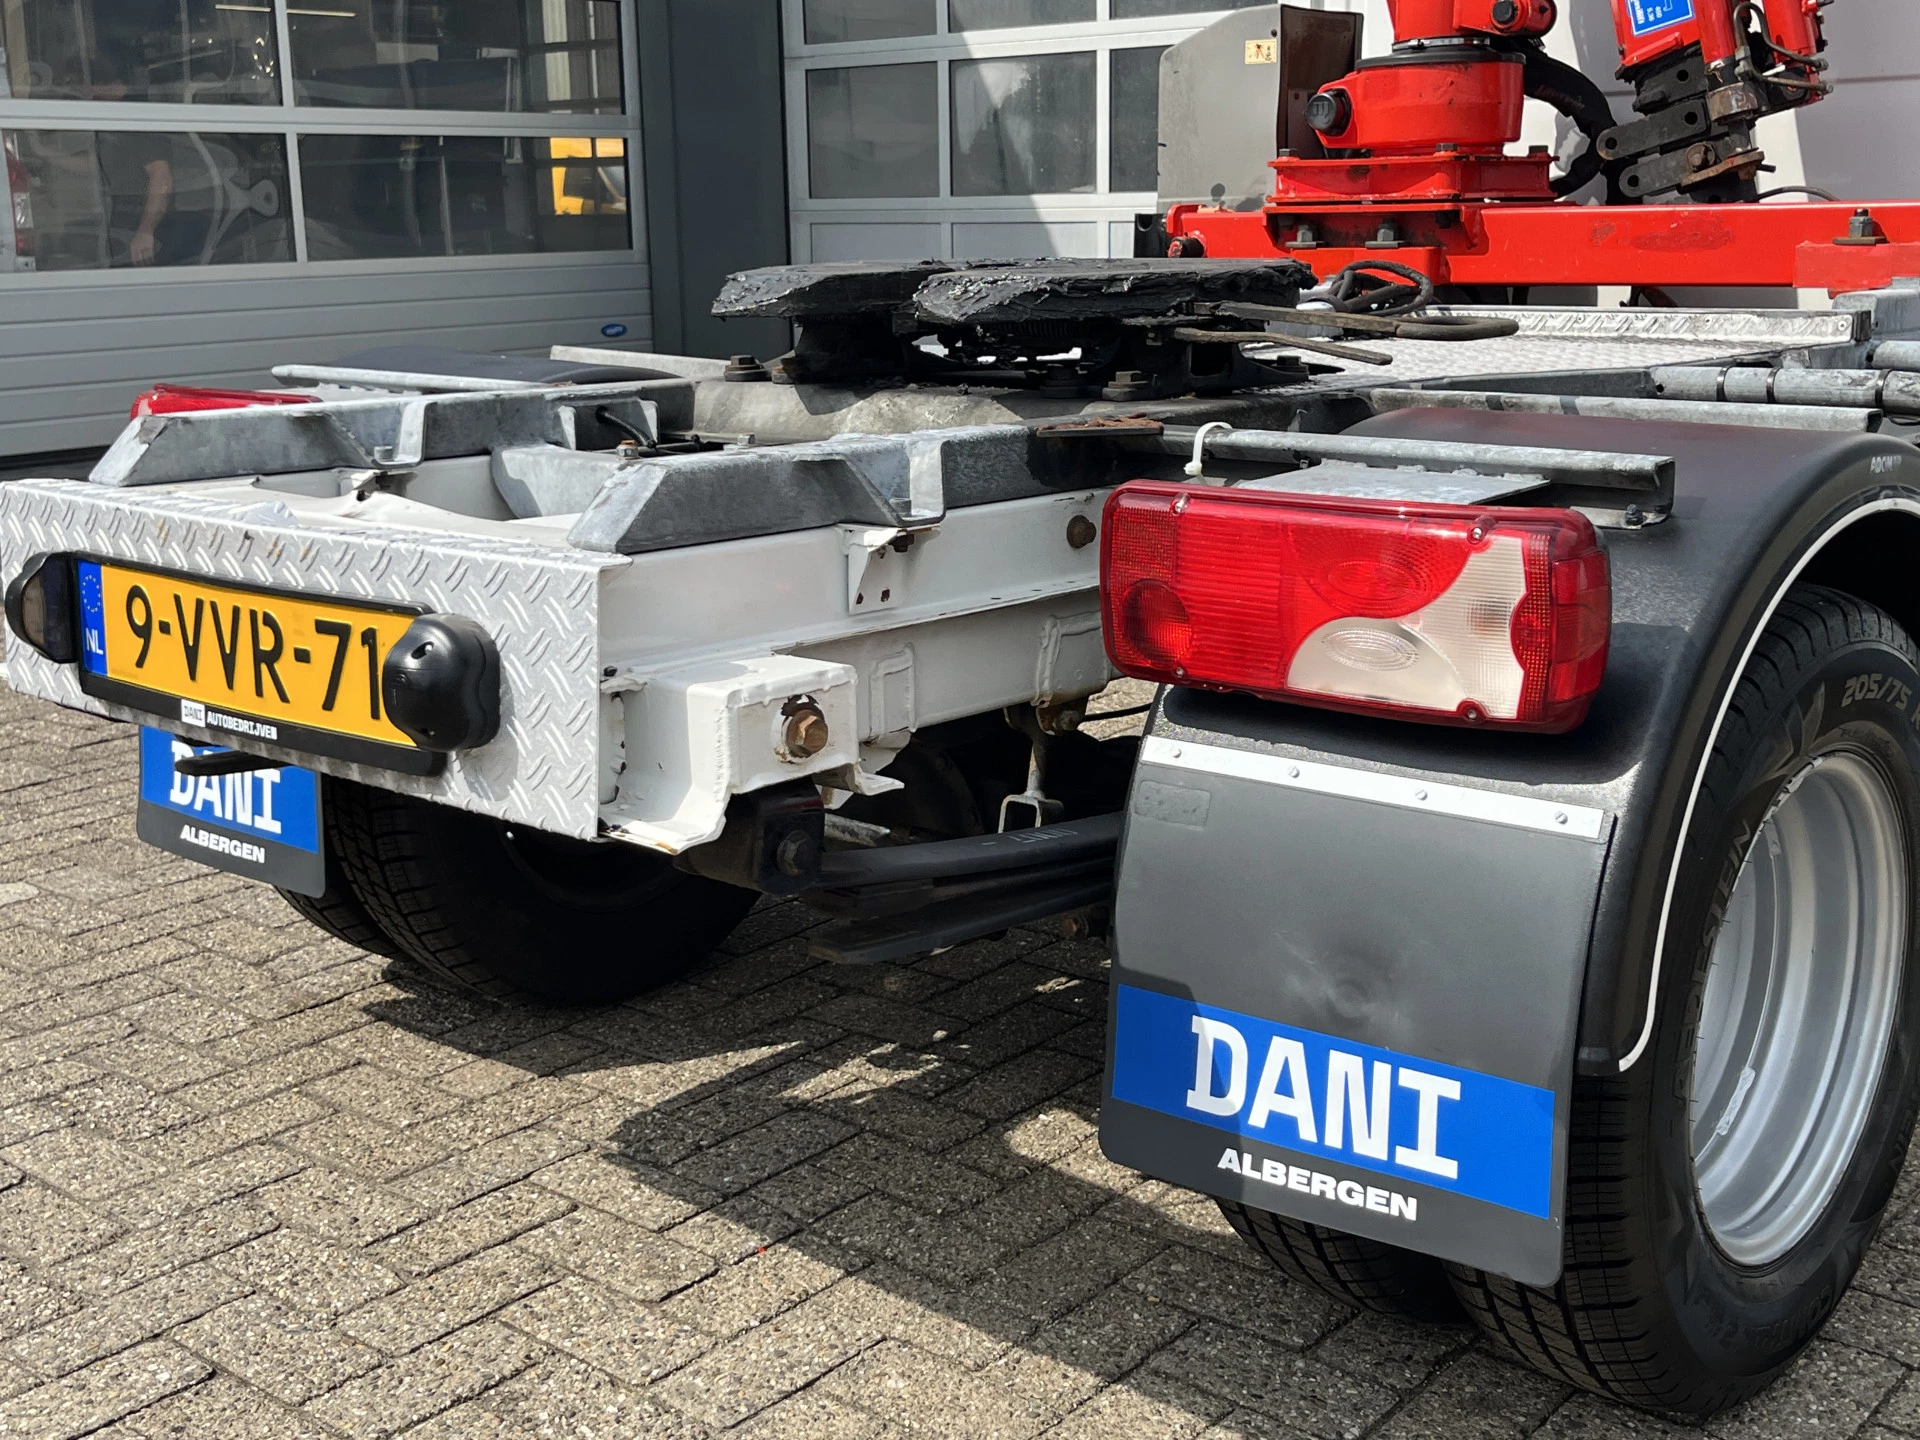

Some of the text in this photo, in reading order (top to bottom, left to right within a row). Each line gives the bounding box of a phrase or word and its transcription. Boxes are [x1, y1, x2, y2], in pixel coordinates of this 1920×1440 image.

[86, 628, 104, 656] NL
[126, 584, 381, 721] 9-VVR-71
[1841, 673, 1913, 711] 205/75
[183, 706, 278, 740] DANI AUTOBEDRIJVEN
[170, 740, 282, 835] DANI
[180, 824, 265, 864] ALBERGEN
[1186, 1014, 1461, 1180] DANI
[1217, 1147, 1418, 1221] ALBERGEN
